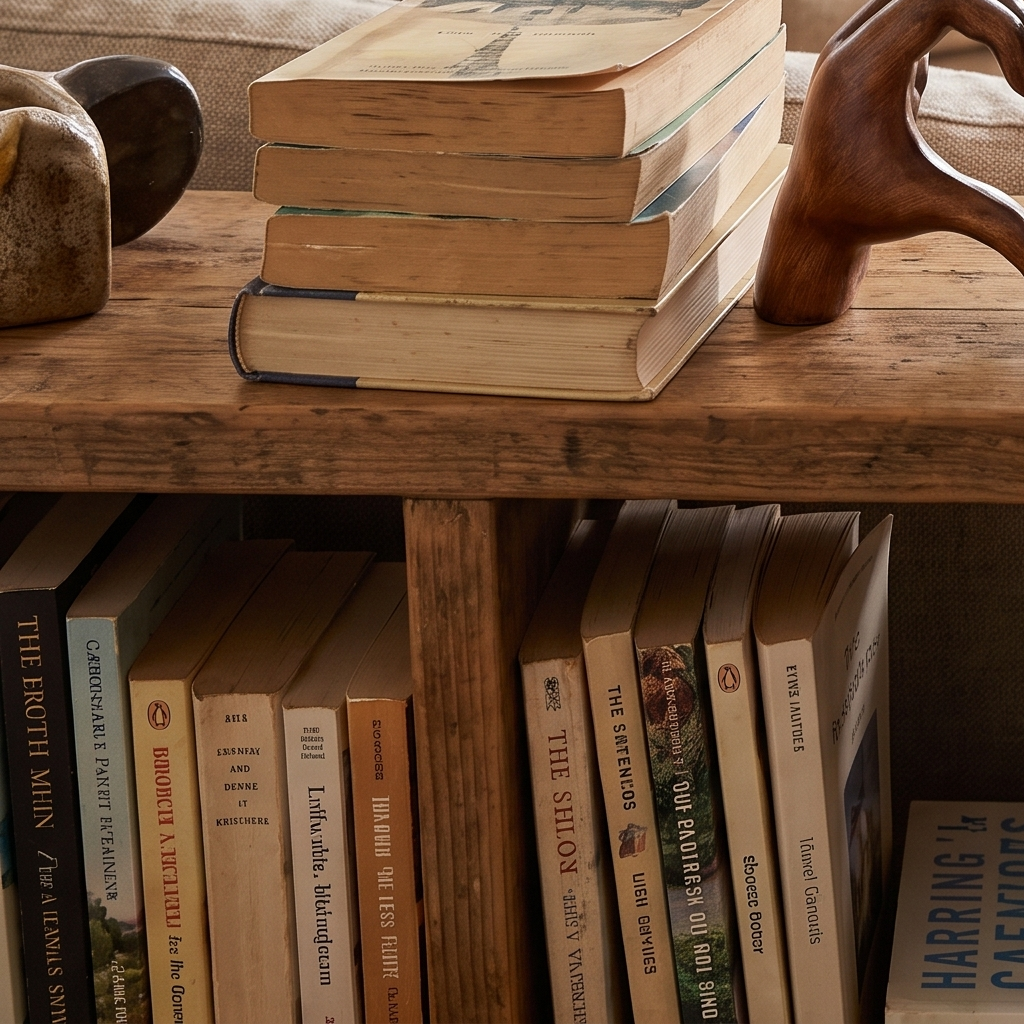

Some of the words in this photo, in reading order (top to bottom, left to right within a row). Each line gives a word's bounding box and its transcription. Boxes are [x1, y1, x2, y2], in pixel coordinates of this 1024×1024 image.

[17, 615, 42, 669] THE
[22, 676, 50, 757] EROTH
[608, 685, 624, 718] THE
[230, 765, 250, 773] AND
[548, 729, 570, 781] THE
[224, 782, 259, 791] DENNE
[216, 817, 269, 827] KRISCHERE
